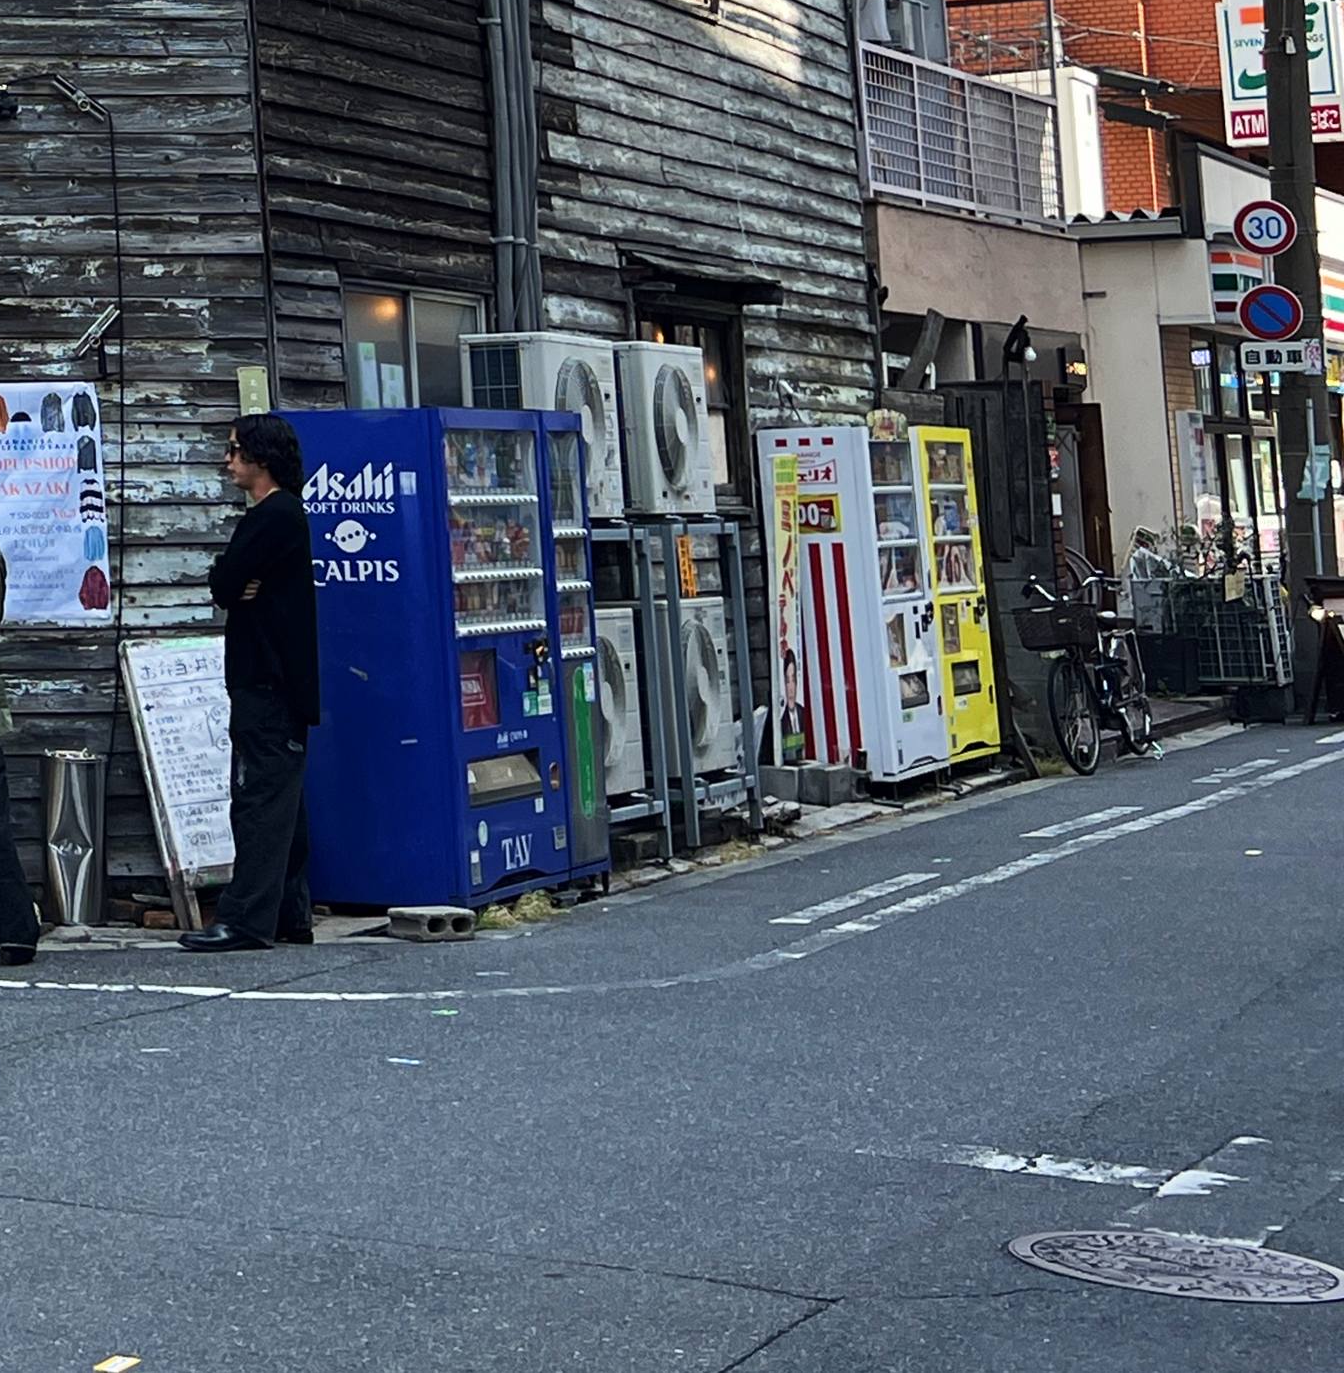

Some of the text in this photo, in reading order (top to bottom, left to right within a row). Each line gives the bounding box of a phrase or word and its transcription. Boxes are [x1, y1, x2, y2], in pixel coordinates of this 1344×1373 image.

[1234, 113, 1265, 135] ATM
[1248, 216, 1282, 240] 30
[1245, 349, 1303, 365] 自動車
[301, 462, 394, 501] Asahi
[797, 465, 832, 482] ェリオ
[302, 501, 395, 514] SOFT DRINKS
